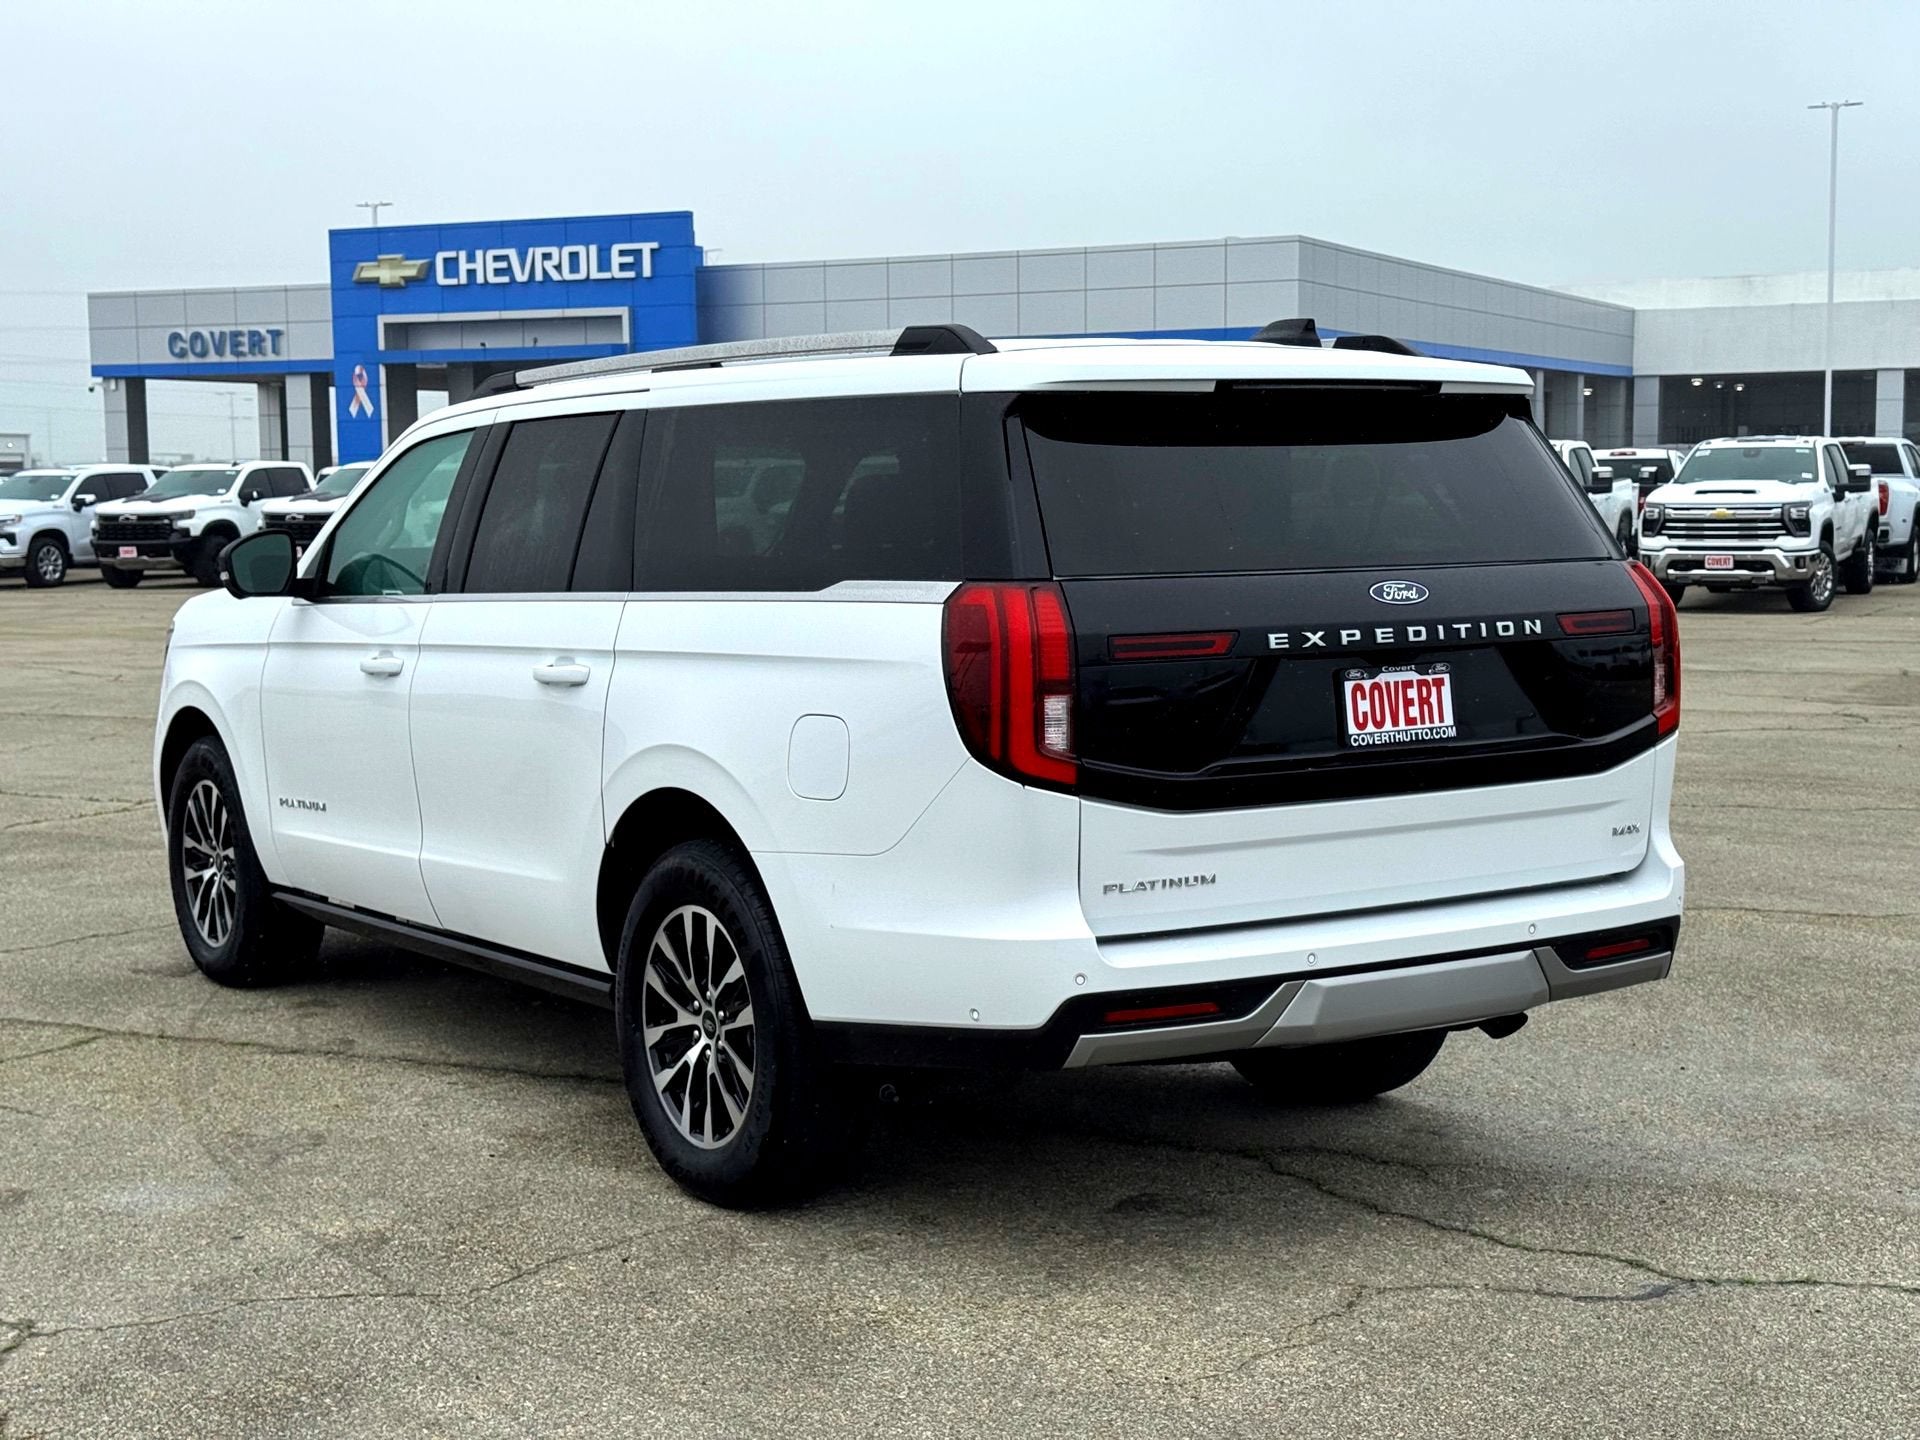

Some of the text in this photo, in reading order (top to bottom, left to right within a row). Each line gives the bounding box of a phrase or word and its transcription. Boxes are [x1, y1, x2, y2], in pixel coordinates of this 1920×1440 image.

[435, 241, 660, 286] CHEVROLET
[168, 328, 284, 358] COVERT
[1268, 619, 1543, 650] EXPEDITION
[1381, 664, 1416, 673] Covert
[1351, 677, 1446, 732] COVERT
[1350, 726, 1457, 747] COVERTHUTTO.COM
[1612, 823, 1640, 837] MAX
[1102, 872, 1217, 895] PLATINUM
